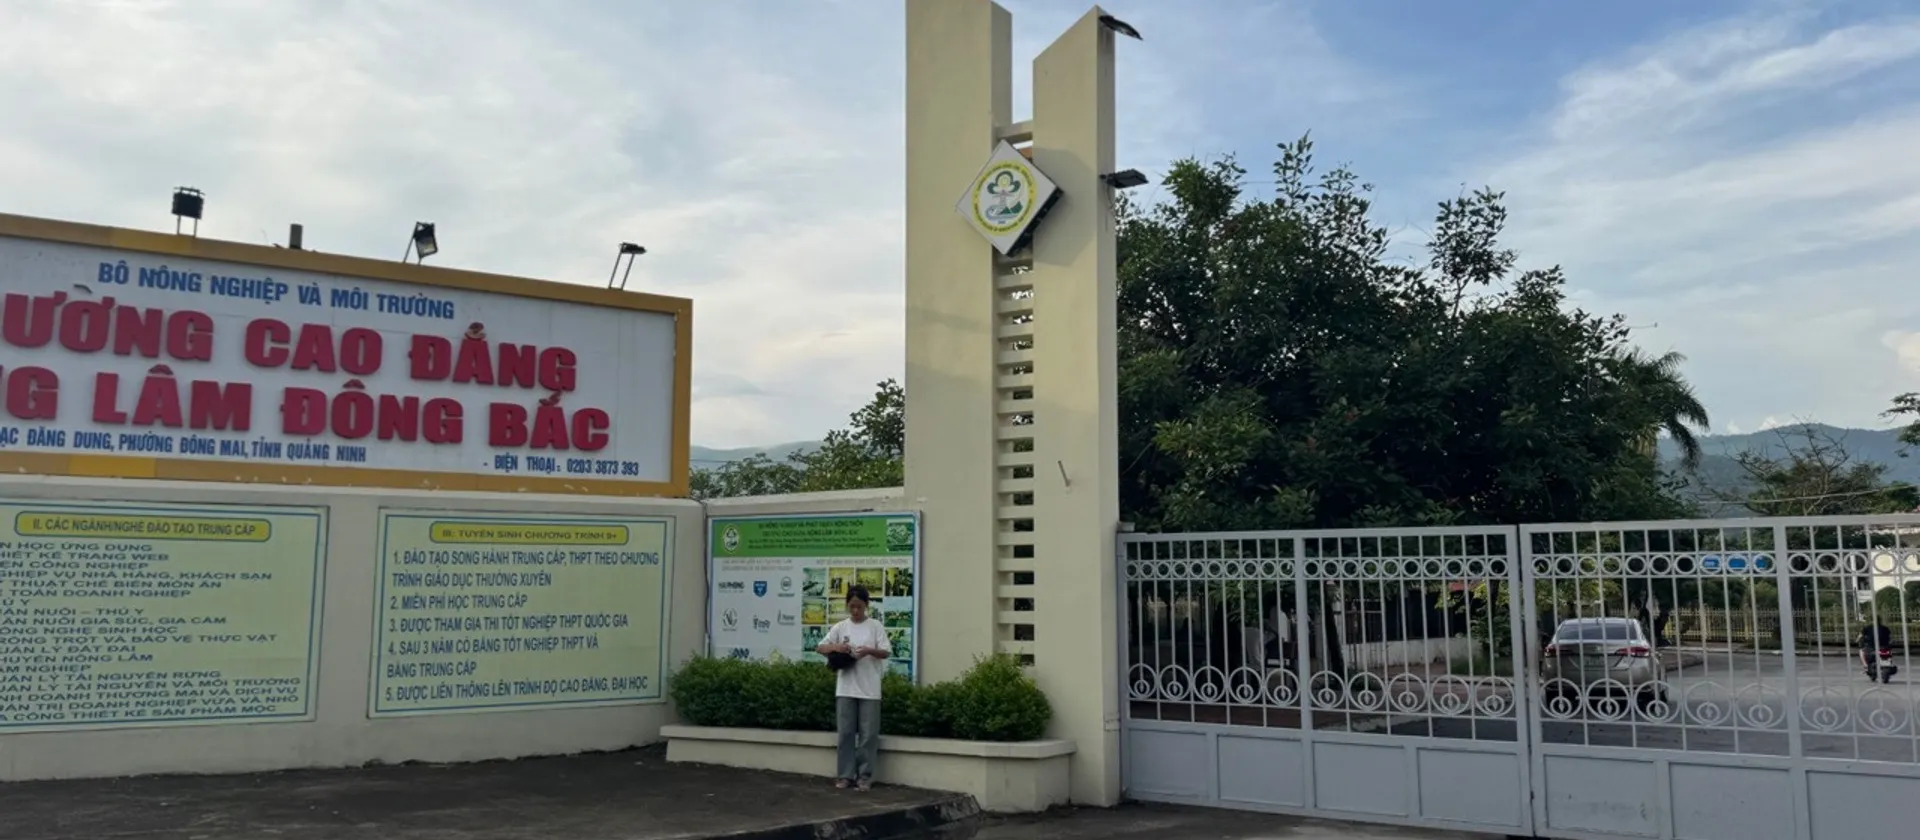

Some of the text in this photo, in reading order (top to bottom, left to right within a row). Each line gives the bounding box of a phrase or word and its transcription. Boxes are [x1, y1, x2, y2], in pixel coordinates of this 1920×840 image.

[138, 265, 202, 293] NÔNG
[210, 277, 289, 304] NGHIỆP
[297, 282, 322, 306] VÀ
[330, 286, 369, 310] MÔI
[376, 292, 454, 319] TRƯỜNG
[245, 318, 383, 377] CAO
[408, 322, 577, 392] ĐẲNG
[0, 364, 610, 452] G LÂM ĐÔNG BẮC
[27, 427, 66, 447] ĐĂNG
[119, 430, 173, 453] PHƯỜNG
[180, 434, 216, 455] ĐÔNG
[251, 436, 282, 459] TỈNH
[286, 438, 330, 461] QUẢNG
[336, 445, 367, 462] NINH
[494, 452, 518, 473] ĐIỆN
[566, 458, 592, 474] 0203
[595, 459, 618, 475] 3873
[45, 517, 69, 531] CÁC
[147, 519, 171, 534] ĐÀO
[173, 522, 195, 536] TẠO
[197, 523, 232, 536] TRUNG
[234, 522, 257, 536] CẤP
[497, 530, 521, 539] SINH
[29, 560, 80, 569] CÔNG
[68, 552, 169, 561] TRANG WEB
[404, 548, 426, 565] ĐÀO
[429, 550, 450, 568] TẠO
[451, 550, 480, 565] SONG
[482, 548, 509, 565] HÀNH
[512, 551, 544, 565] TRUNG
[569, 551, 592, 565] THPT
[594, 551, 618, 565] THEO
[620, 551, 659, 565] CHƯƠNG
[82, 570, 117, 579] NHÀ
[180, 570, 236, 580] KHÁCH
[392, 569, 552, 590] TRÌNH GIÁO DỤC THƯỜNG XUYÊN
[62, 589, 124, 597] DOANH
[428, 591, 446, 609] PHÍ
[447, 595, 469, 612] HỌC
[472, 595, 505, 609] TRUNG
[507, 591, 528, 608] CẤP
[34, 607, 77, 616] NUÔI
[33, 617, 75, 625] NUÔI
[80, 617, 110, 625] GIA
[158, 617, 187, 625] GIA
[97, 626, 137, 634] SINH
[400, 618, 432, 635] ĐƯỢC
[434, 617, 462, 632] THAM
[464, 617, 482, 631] GIA
[484, 616, 499, 631] THI
[501, 614, 520, 630] TỐT
[522, 615, 557, 632] NGHIỆP
[559, 614, 583, 628] THPT
[584, 612, 611, 628] QUỐC
[613, 614, 629, 628] GIA
[399, 640, 421, 655] SAU
[423, 640, 429, 654] 3
[431, 637, 453, 653] NĂM
[456, 636, 470, 653] CÓ
[503, 635, 522, 652] TỐT
[524, 635, 559, 654] NGHIỆP
[561, 636, 584, 650] THPT
[586, 632, 599, 648] VÀ
[62, 654, 113, 663] NÔNG
[419, 662, 454, 677] TRUNG
[456, 659, 477, 676] CẤP
[28, 693, 90, 702] DOANH
[397, 686, 428, 703] ĐƯỢC
[430, 681, 453, 699] LIÊN
[456, 680, 490, 698] THÔNG
[492, 679, 511, 696] LÊN
[513, 677, 541, 695] TRÌNH
[543, 679, 558, 697] ĐỘ
[559, 678, 579, 693] CAO
[612, 677, 627, 694] ĐẠI
[629, 676, 648, 693] HỌC
[68, 701, 130, 710] DOANH
[13, 712, 65, 721] CÔNG
